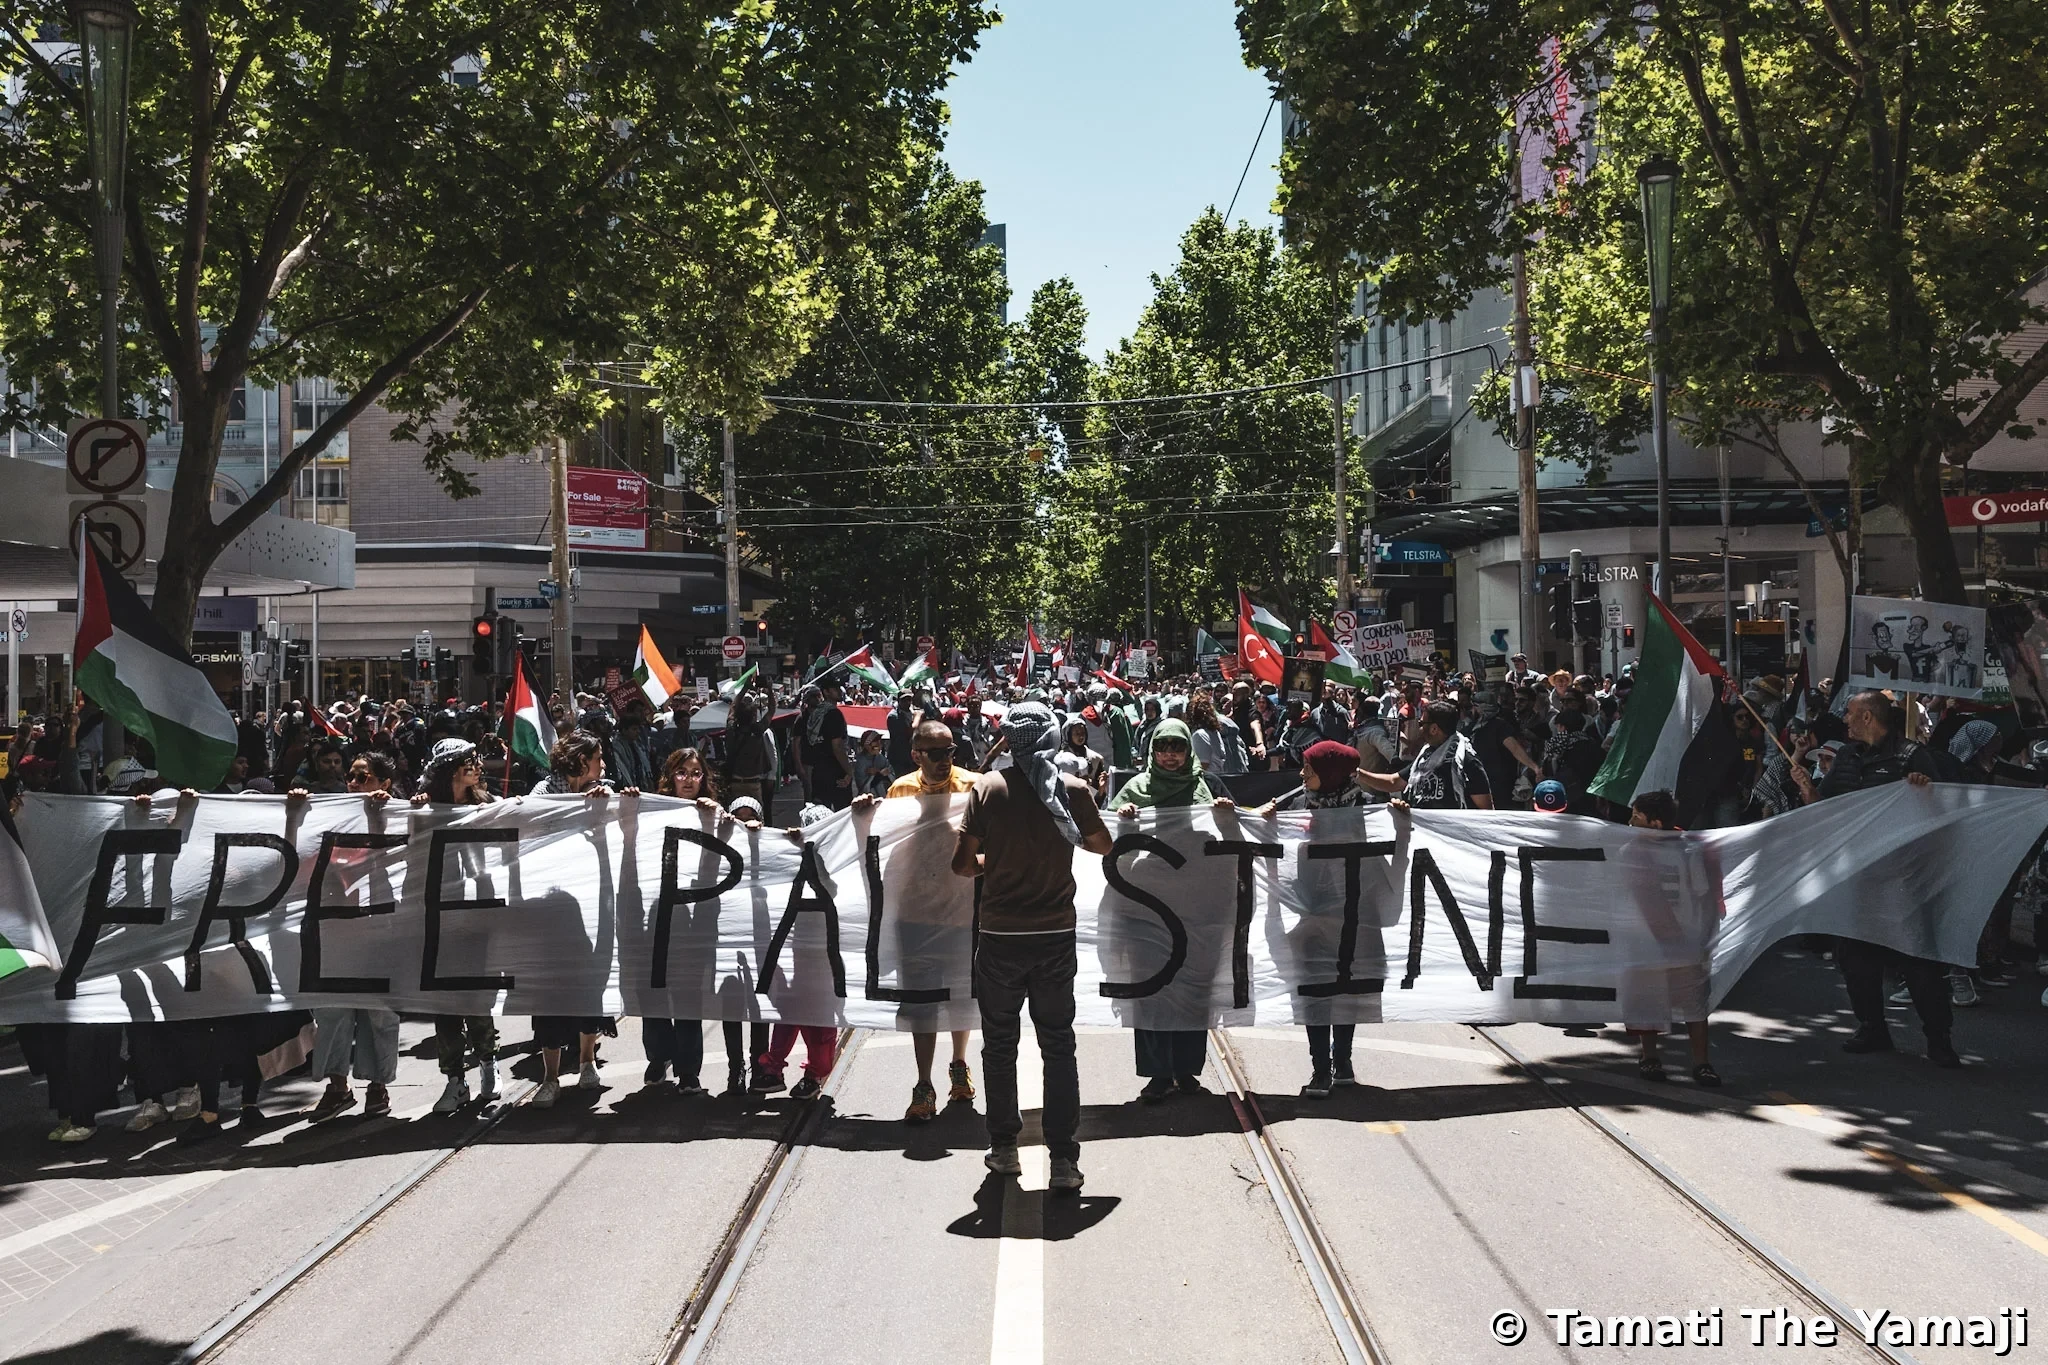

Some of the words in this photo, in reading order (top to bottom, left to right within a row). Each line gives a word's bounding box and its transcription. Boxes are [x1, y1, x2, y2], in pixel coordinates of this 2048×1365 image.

[568, 491, 582, 500] For
[583, 492, 601, 501] Sale
[1404, 550, 1441, 560] TELSTRA
[497, 598, 521, 606] Bourke
[524, 598, 533, 606] St
[1363, 623, 1404, 640] CONDEMN
[1357, 653, 1383, 668] YOUR
[1384, 648, 1410, 665] DAD!
[55, 827, 519, 1000] FREE
[651, 826, 1616, 1008] PALSTINE
